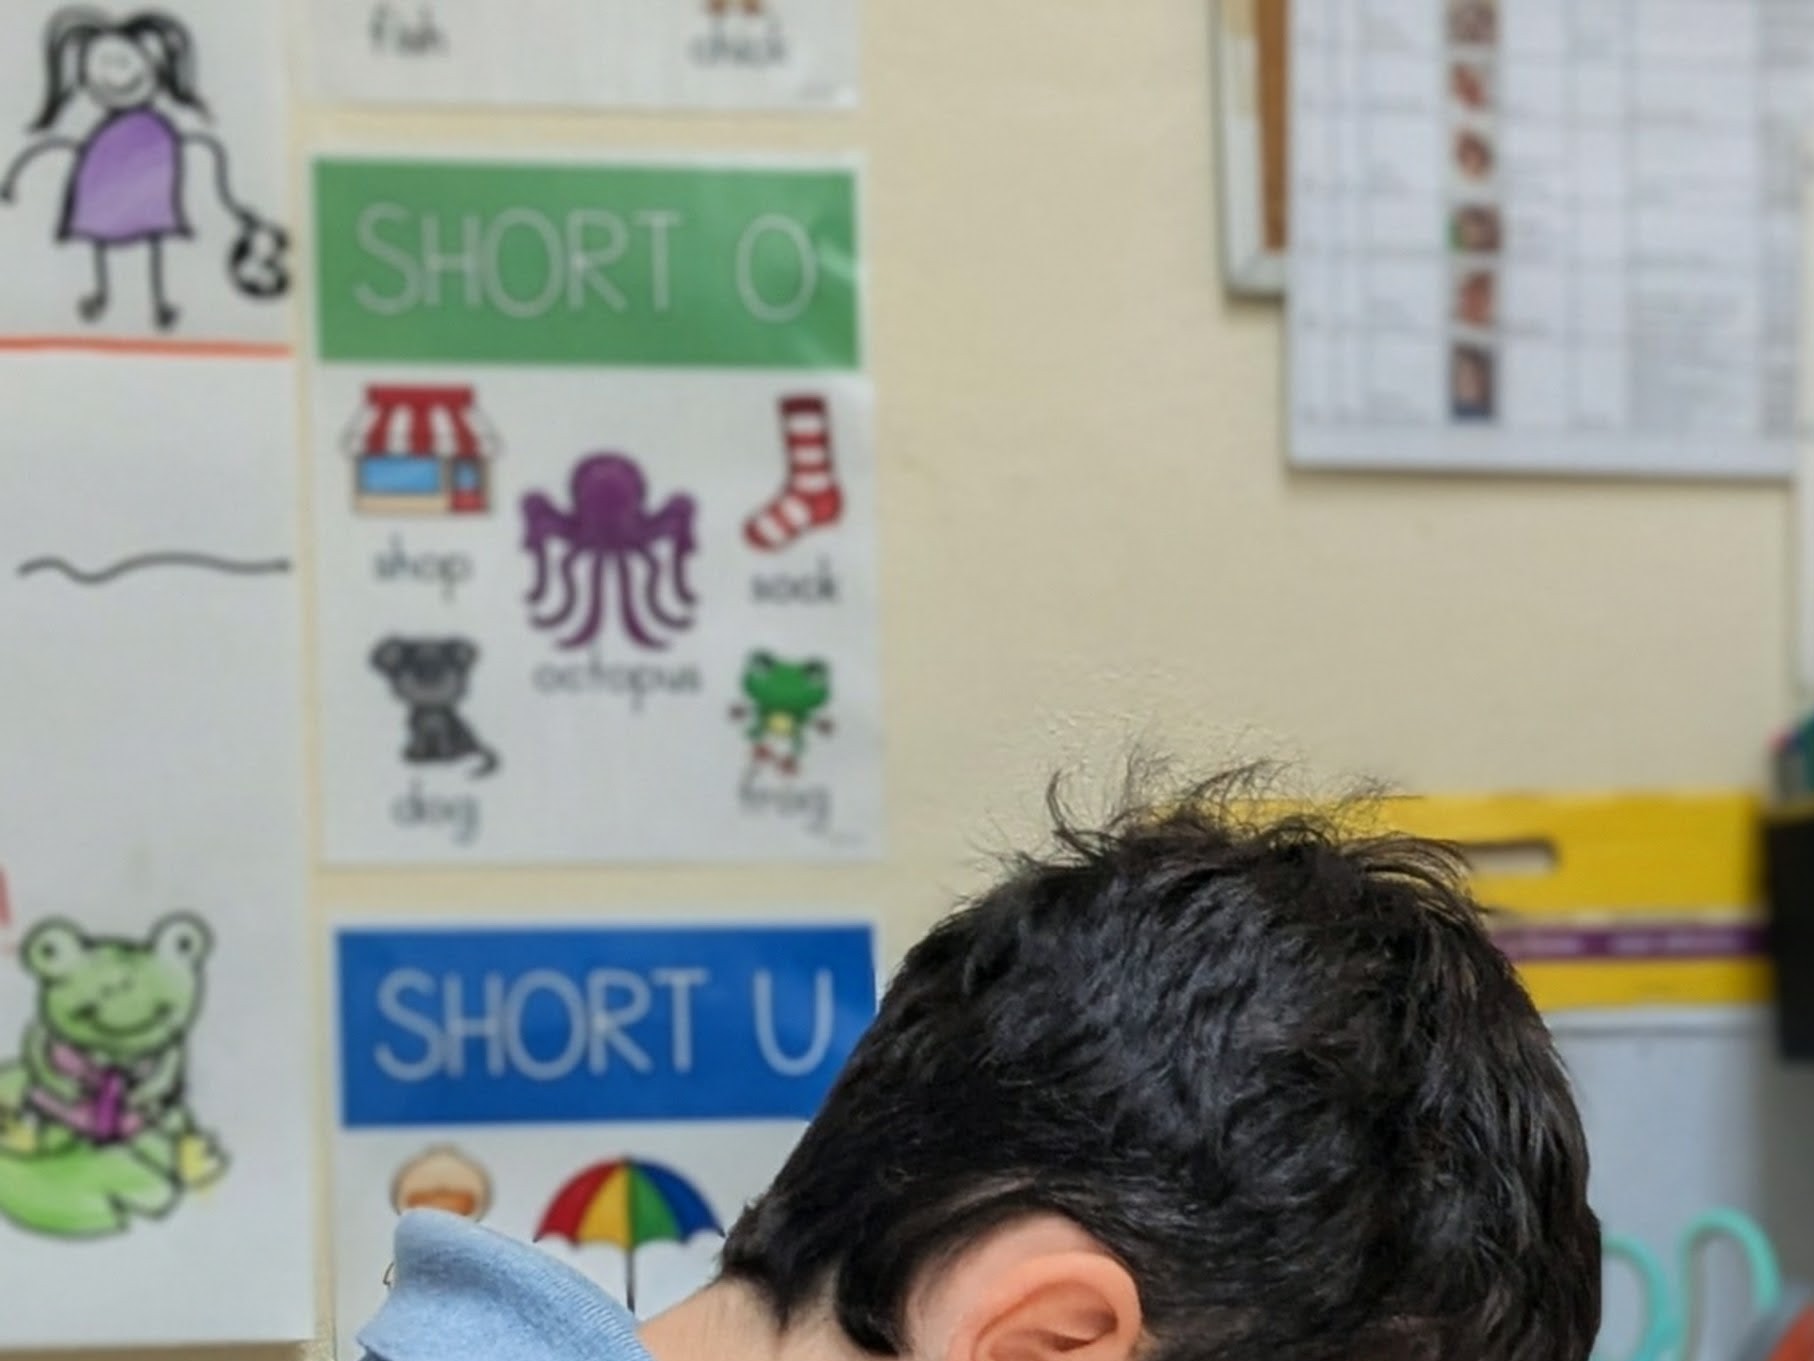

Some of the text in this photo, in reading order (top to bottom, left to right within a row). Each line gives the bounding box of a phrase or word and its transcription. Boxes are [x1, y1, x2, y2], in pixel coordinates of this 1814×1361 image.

[367, 4, 449, 58] fish
[689, 20, 787, 67] chick
[353, 201, 820, 324] SHORT O
[372, 534, 473, 601] shop
[750, 557, 842, 604] sock
[532, 646, 703, 713] octopus
[391, 778, 481, 844] dog
[738, 757, 833, 834] frog
[374, 967, 835, 1081] SHORT U
